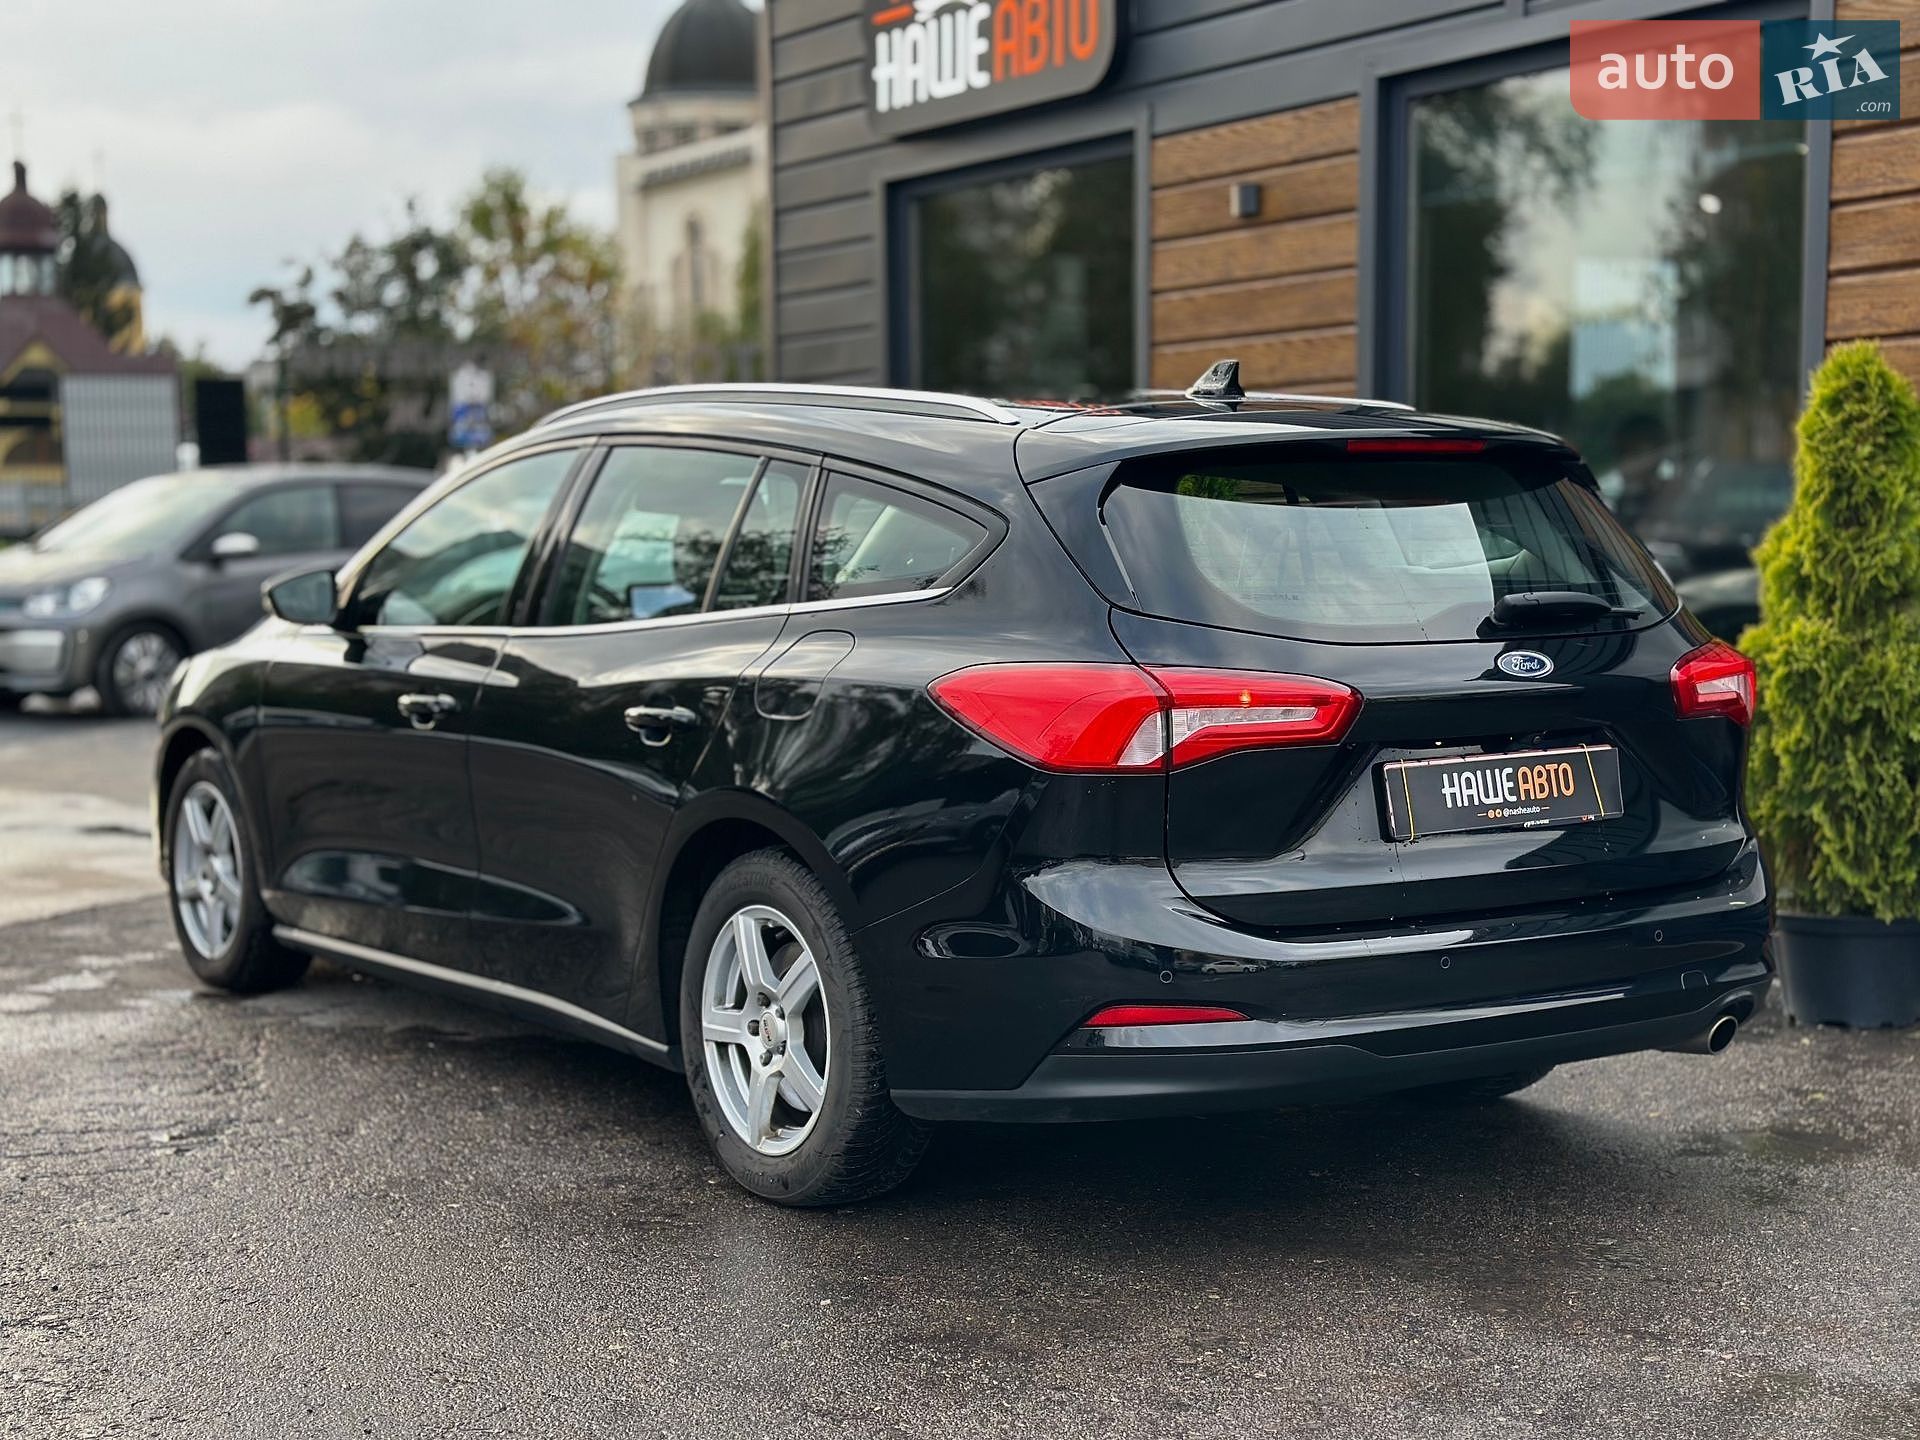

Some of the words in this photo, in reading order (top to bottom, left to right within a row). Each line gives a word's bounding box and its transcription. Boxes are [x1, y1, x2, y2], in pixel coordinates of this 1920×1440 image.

[872, 3, 991, 112] НАШЕ
[993, 0, 1098, 83] АВТО
[1511, 656, 1540, 670] Ford
[1442, 767, 1517, 808] НАШЕ
[1517, 762, 1575, 800] АВТО
[1503, 806, 1541, 818] @nasheauto
